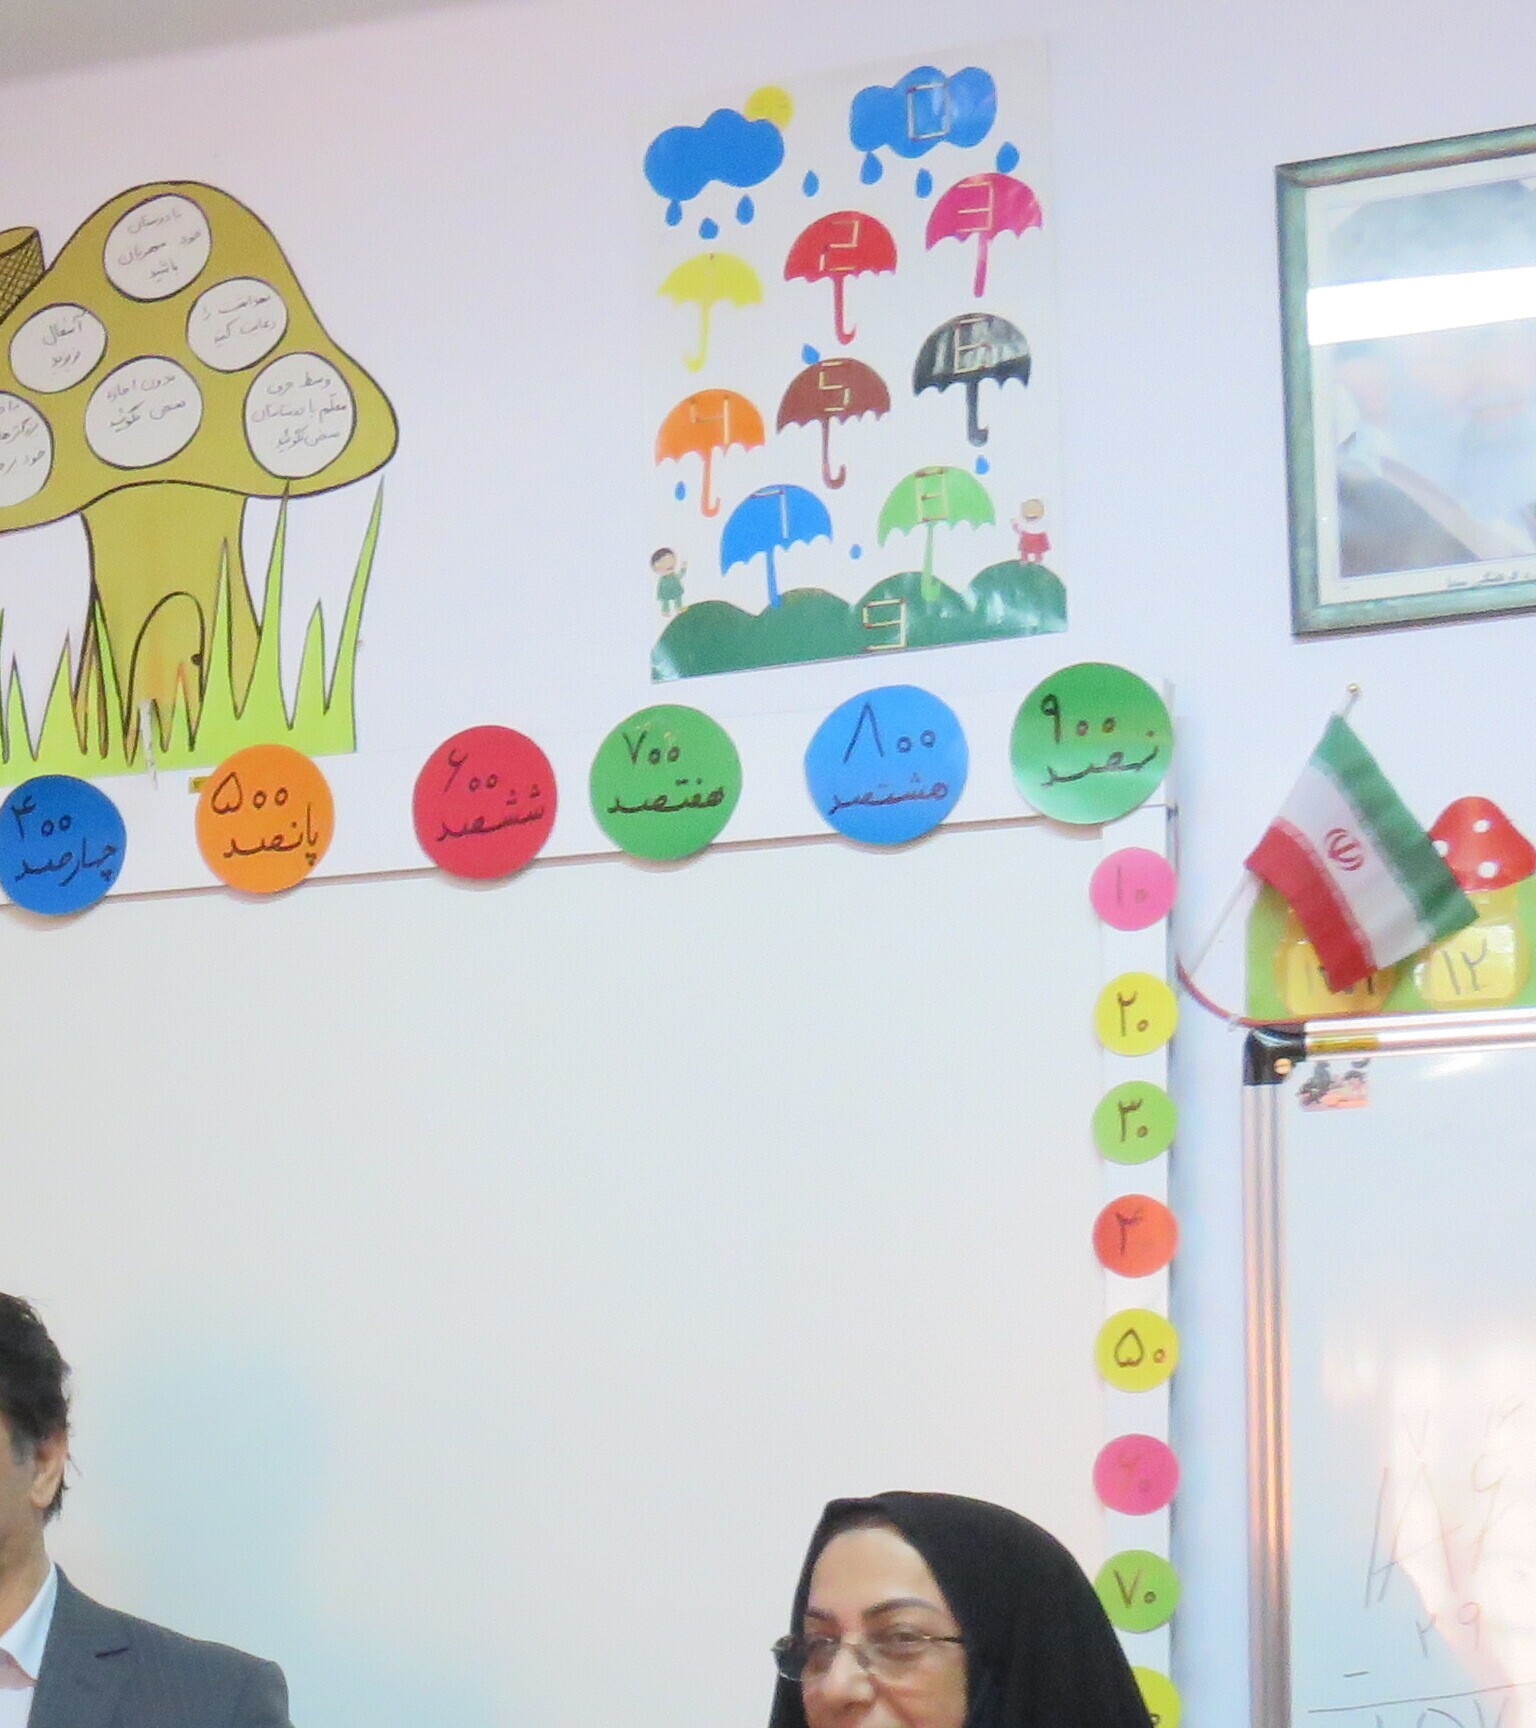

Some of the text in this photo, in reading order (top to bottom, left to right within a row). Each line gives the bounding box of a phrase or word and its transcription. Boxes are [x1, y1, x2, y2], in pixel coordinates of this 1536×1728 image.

[842, 701, 937, 764] ۸۰۰
[1040, 693, 1117, 745] ۹۰۰
[443, 748, 499, 793] ۶۰۰
[622, 730, 681, 766] ۷۰۰
[209, 770, 290, 816] ۵۰۰
[10, 793, 72, 840] ۴۰۰
[222, 802, 320, 867] پانصد
[1117, 990, 1149, 1037] ۲۰
[1113, 1326, 1167, 1368] ۵۰
[1112, 1566, 1157, 1609] ۷۰
